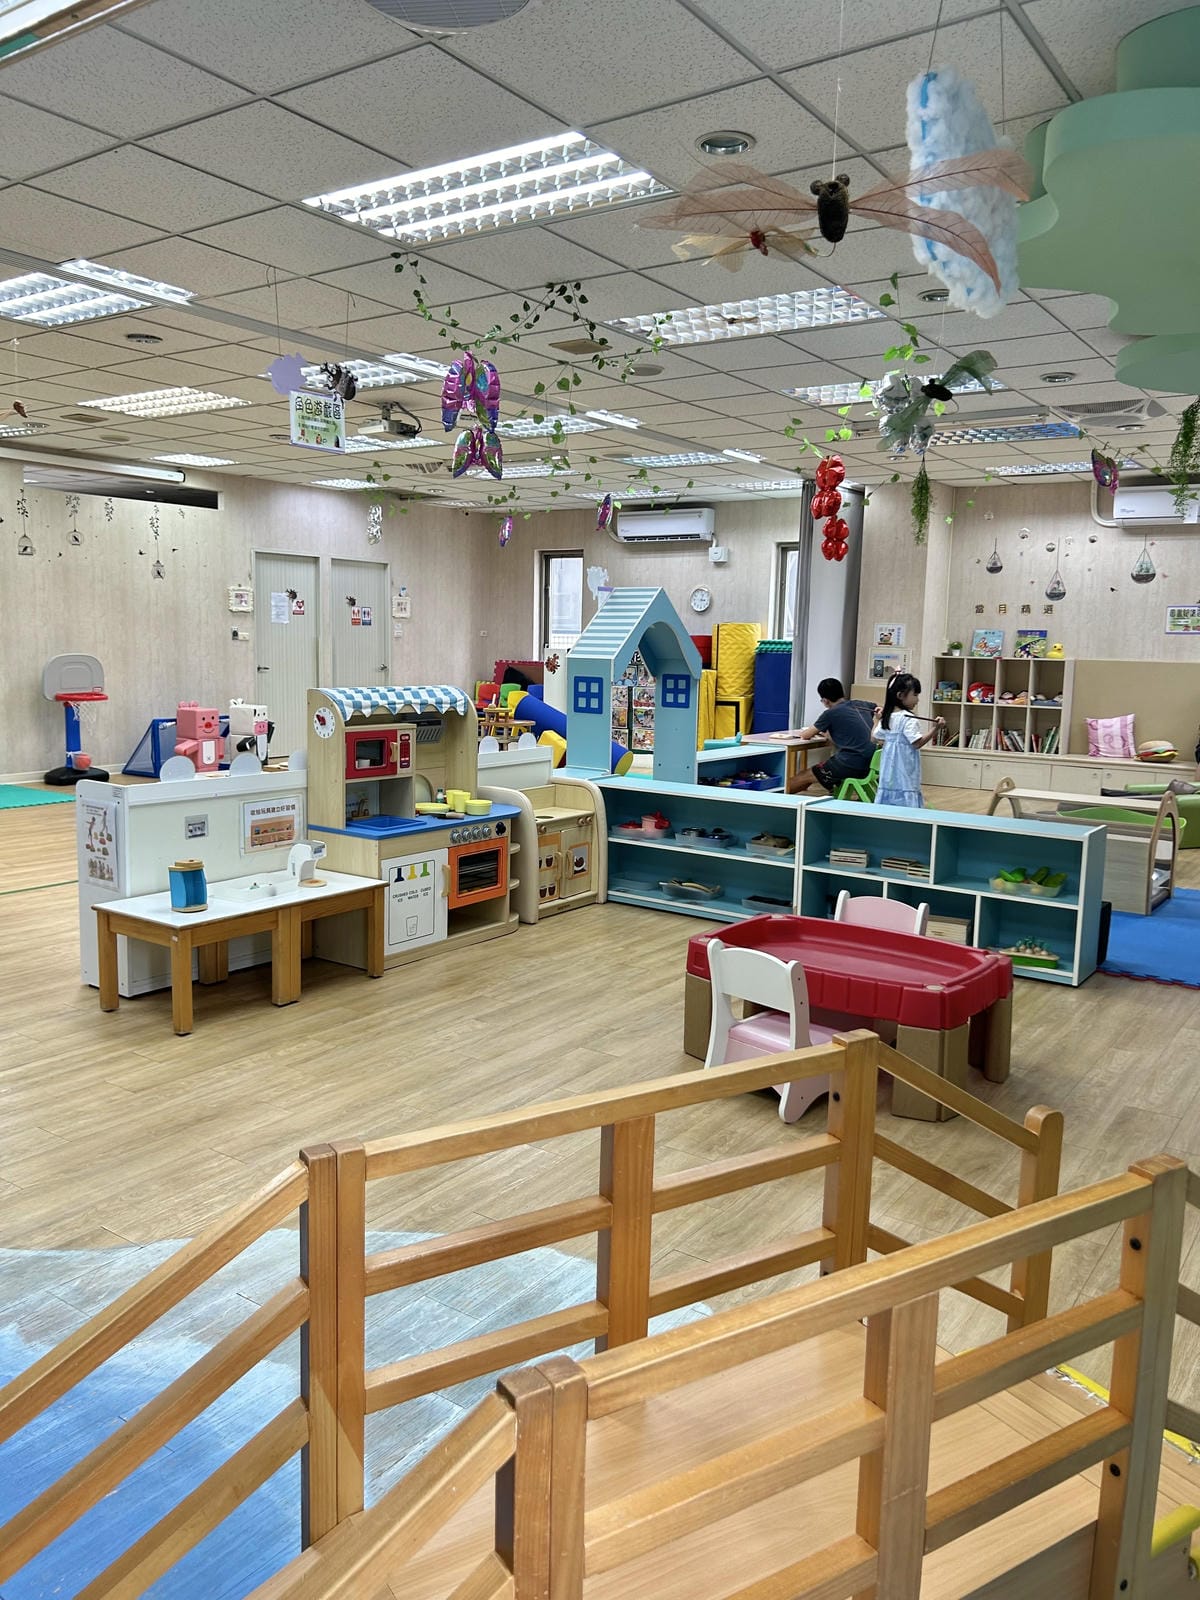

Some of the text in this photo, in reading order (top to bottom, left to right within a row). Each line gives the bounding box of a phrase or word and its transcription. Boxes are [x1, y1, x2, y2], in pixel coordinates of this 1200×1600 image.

[295, 396, 341, 420] 角色遊戲區
[975, 604, 1054, 614] 當月精選
